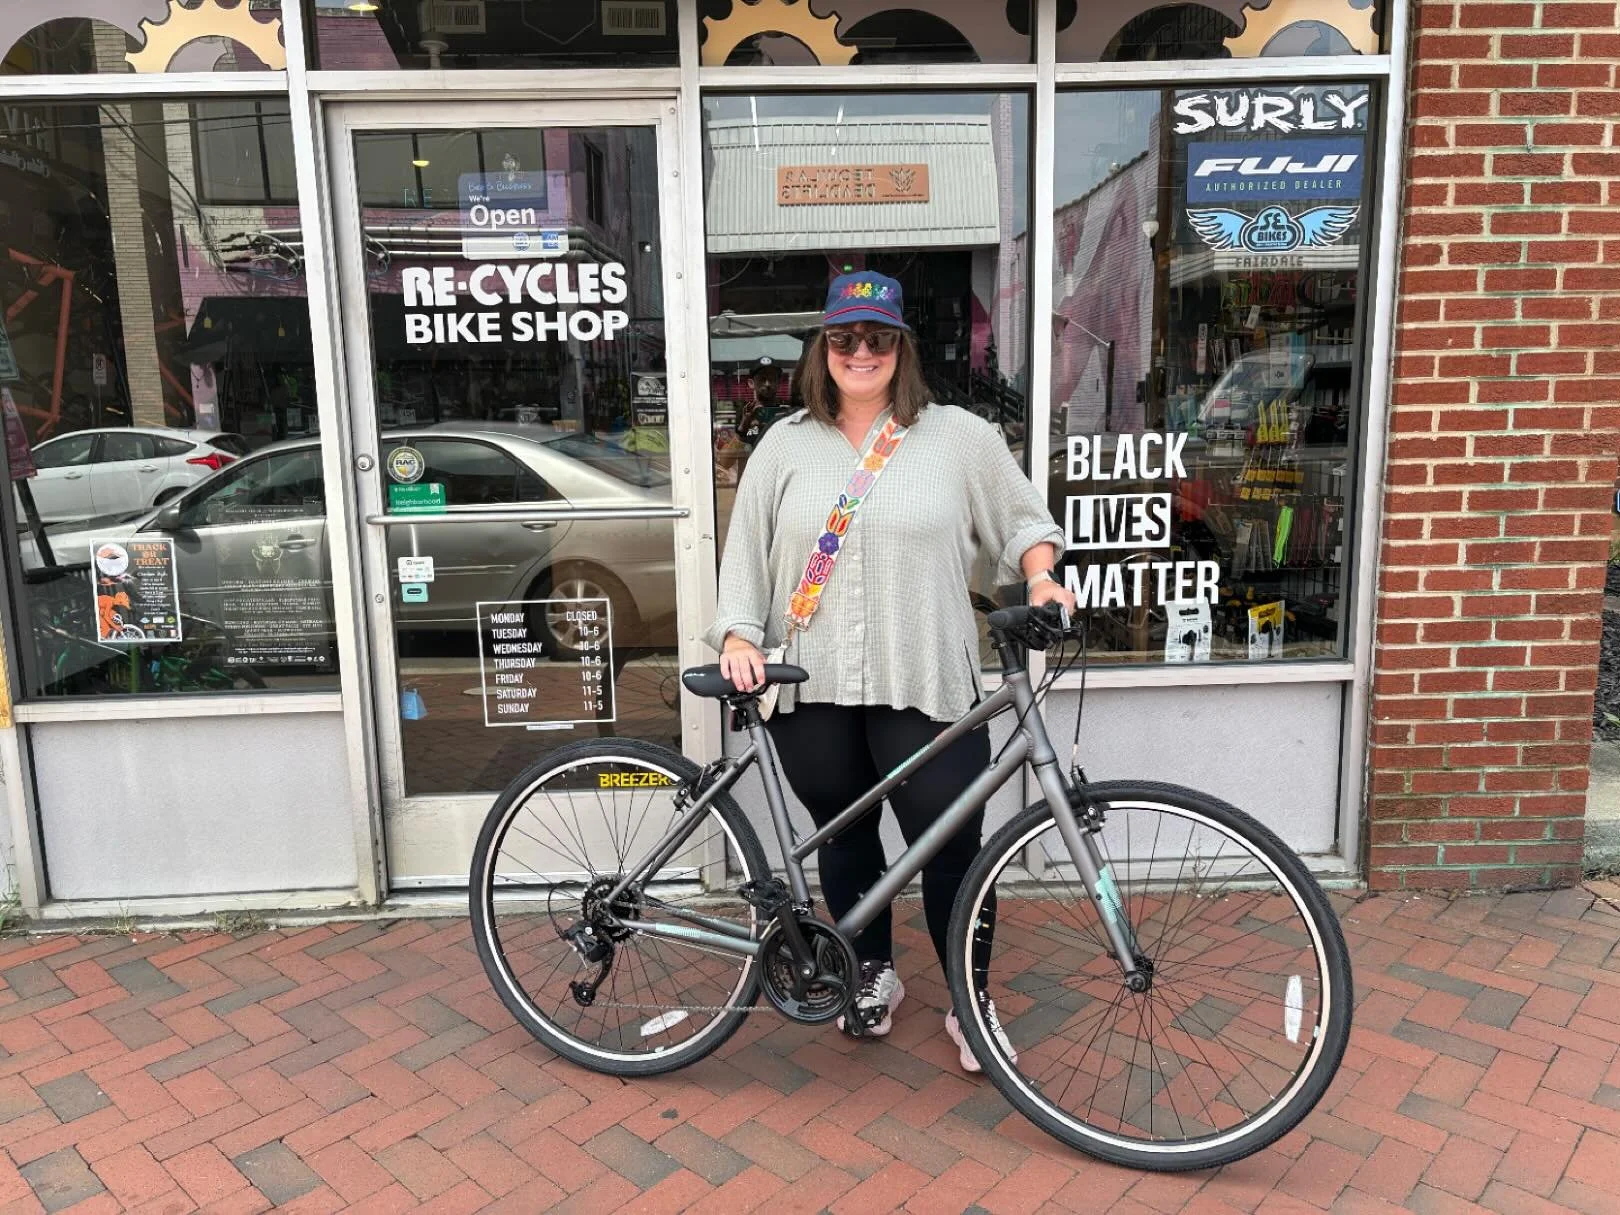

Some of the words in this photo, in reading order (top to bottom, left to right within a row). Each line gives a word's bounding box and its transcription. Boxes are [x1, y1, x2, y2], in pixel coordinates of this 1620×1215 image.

[1172, 92, 1369, 134] SURLY
[1193, 154, 1360, 176] FUJI
[1205, 180, 1287, 192] AUTHORIZED
[1294, 179, 1343, 190] DEALER
[470, 204, 536, 231] Open
[1260, 212, 1285, 230] SE
[1257, 231, 1287, 242] BIKES
[1235, 256, 1304, 267] FAIRDALE
[404, 312, 503, 344] BIKE
[511, 310, 629, 341] SHOP
[1066, 432, 1189, 482] BLACK
[1071, 496, 1167, 544] LIVES
[133, 558, 169, 566] TREAT
[1065, 560, 1220, 610] MATTER
[491, 612, 525, 624] MONDAY
[566, 610, 597, 621] CLOSED
[492, 628, 527, 639] TUESDAY
[579, 626, 599, 636] 10-6
[493, 642, 543, 654] WEDNESDAY
[580, 641, 600, 651] 10-6
[494, 658, 536, 669] THURSDAY
[581, 656, 602, 666] 10-6
[495, 673, 524, 684] FRIDAY
[582, 671, 602, 681] 10-6
[496, 688, 537, 699] SATURDAY
[582, 685, 603, 696] 11-5
[497, 703, 529, 714] SUNDAY
[584, 700, 603, 711] 11-5
